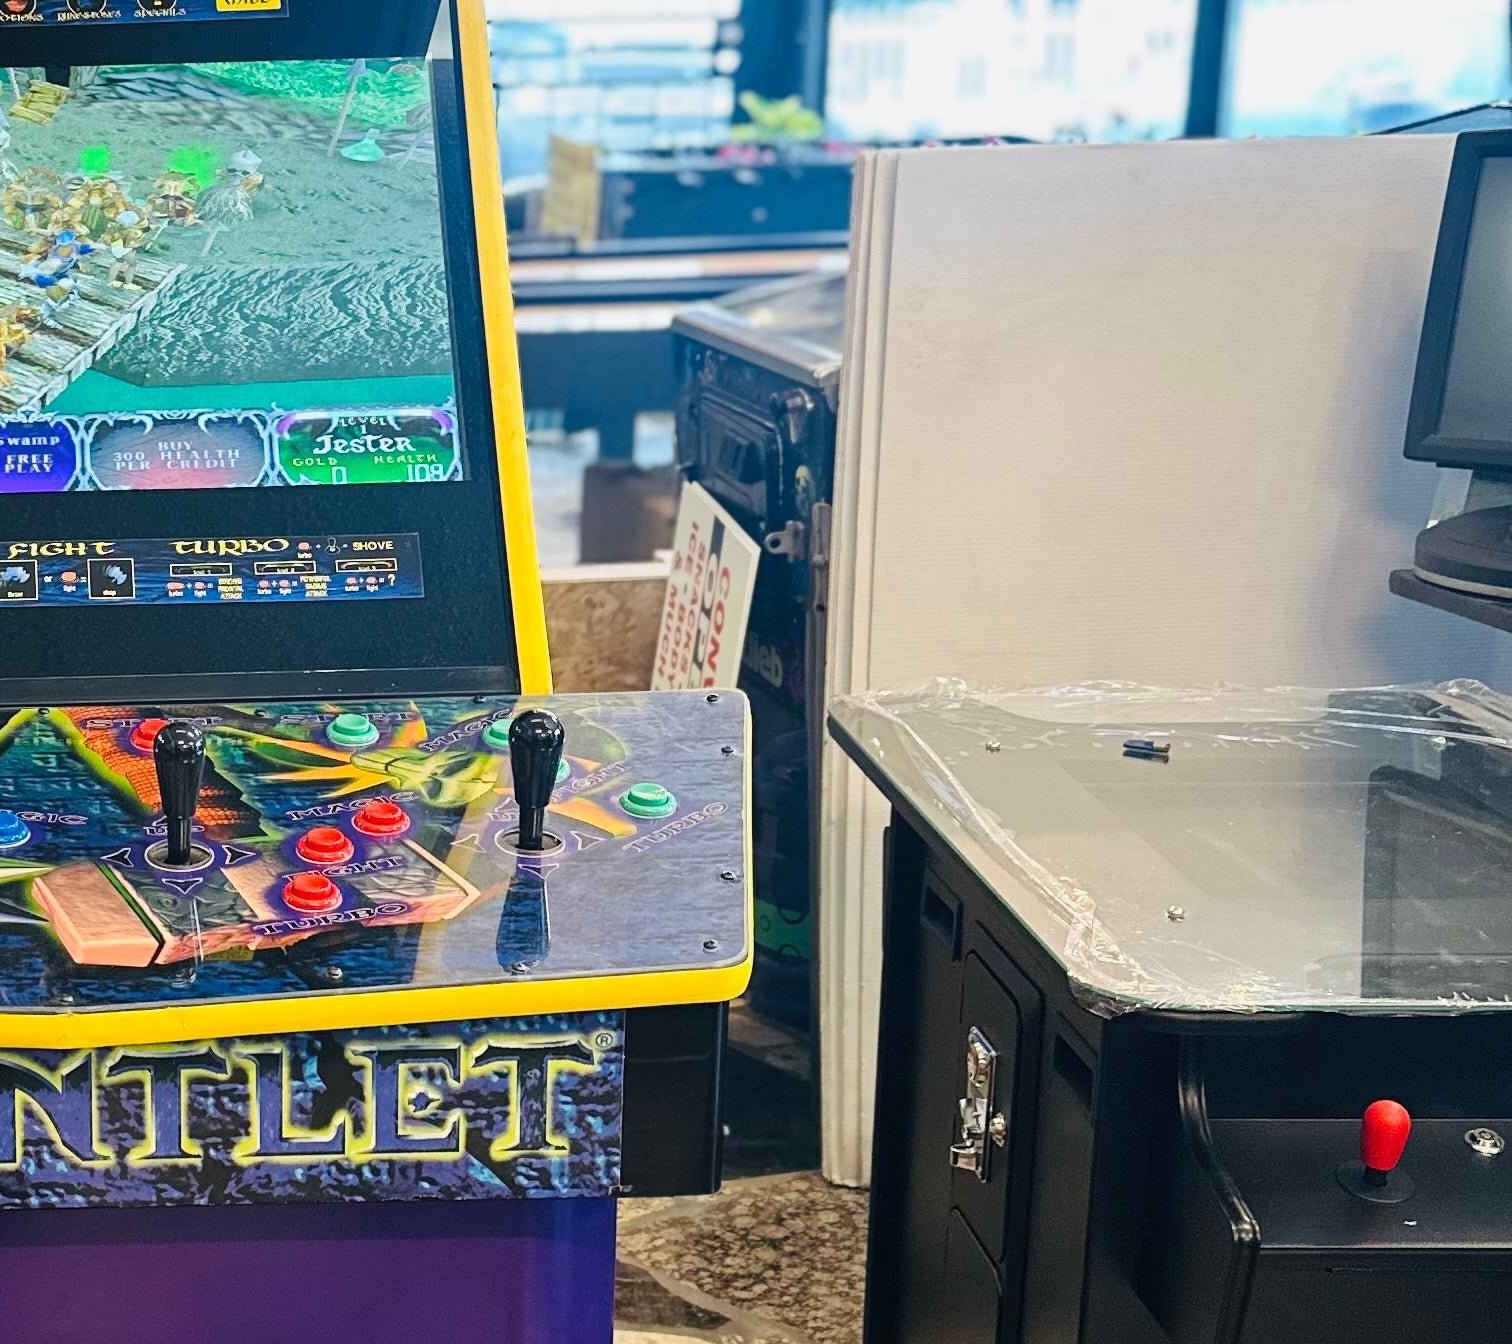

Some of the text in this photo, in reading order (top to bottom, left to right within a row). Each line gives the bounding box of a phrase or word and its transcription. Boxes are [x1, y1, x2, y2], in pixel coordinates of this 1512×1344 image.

[158, 441, 192, 451] BUY
[7, 454, 54, 465] FREE
[113, 449, 240, 462] 300 HEALTH
[166, 459, 239, 469] CREDIT
[293, 455, 437, 466] GOLD HEALTH
[4, 464, 54, 474] PLAY
[7, 541, 116, 559] FIGHT
[169, 538, 290, 556] TURBO
[352, 541, 394, 551] SHOVE
[688, 521, 699, 574] ICE
[681, 543, 706, 673] SNACKS
[657, 584, 678, 677] MUCH
[280, 712, 418, 724] STRT
[419, 708, 513, 752] MAGIC
[551, 760, 632, 802] IGHT
[622, 802, 729, 853] TURBO
[253, 903, 408, 935] TURBO
